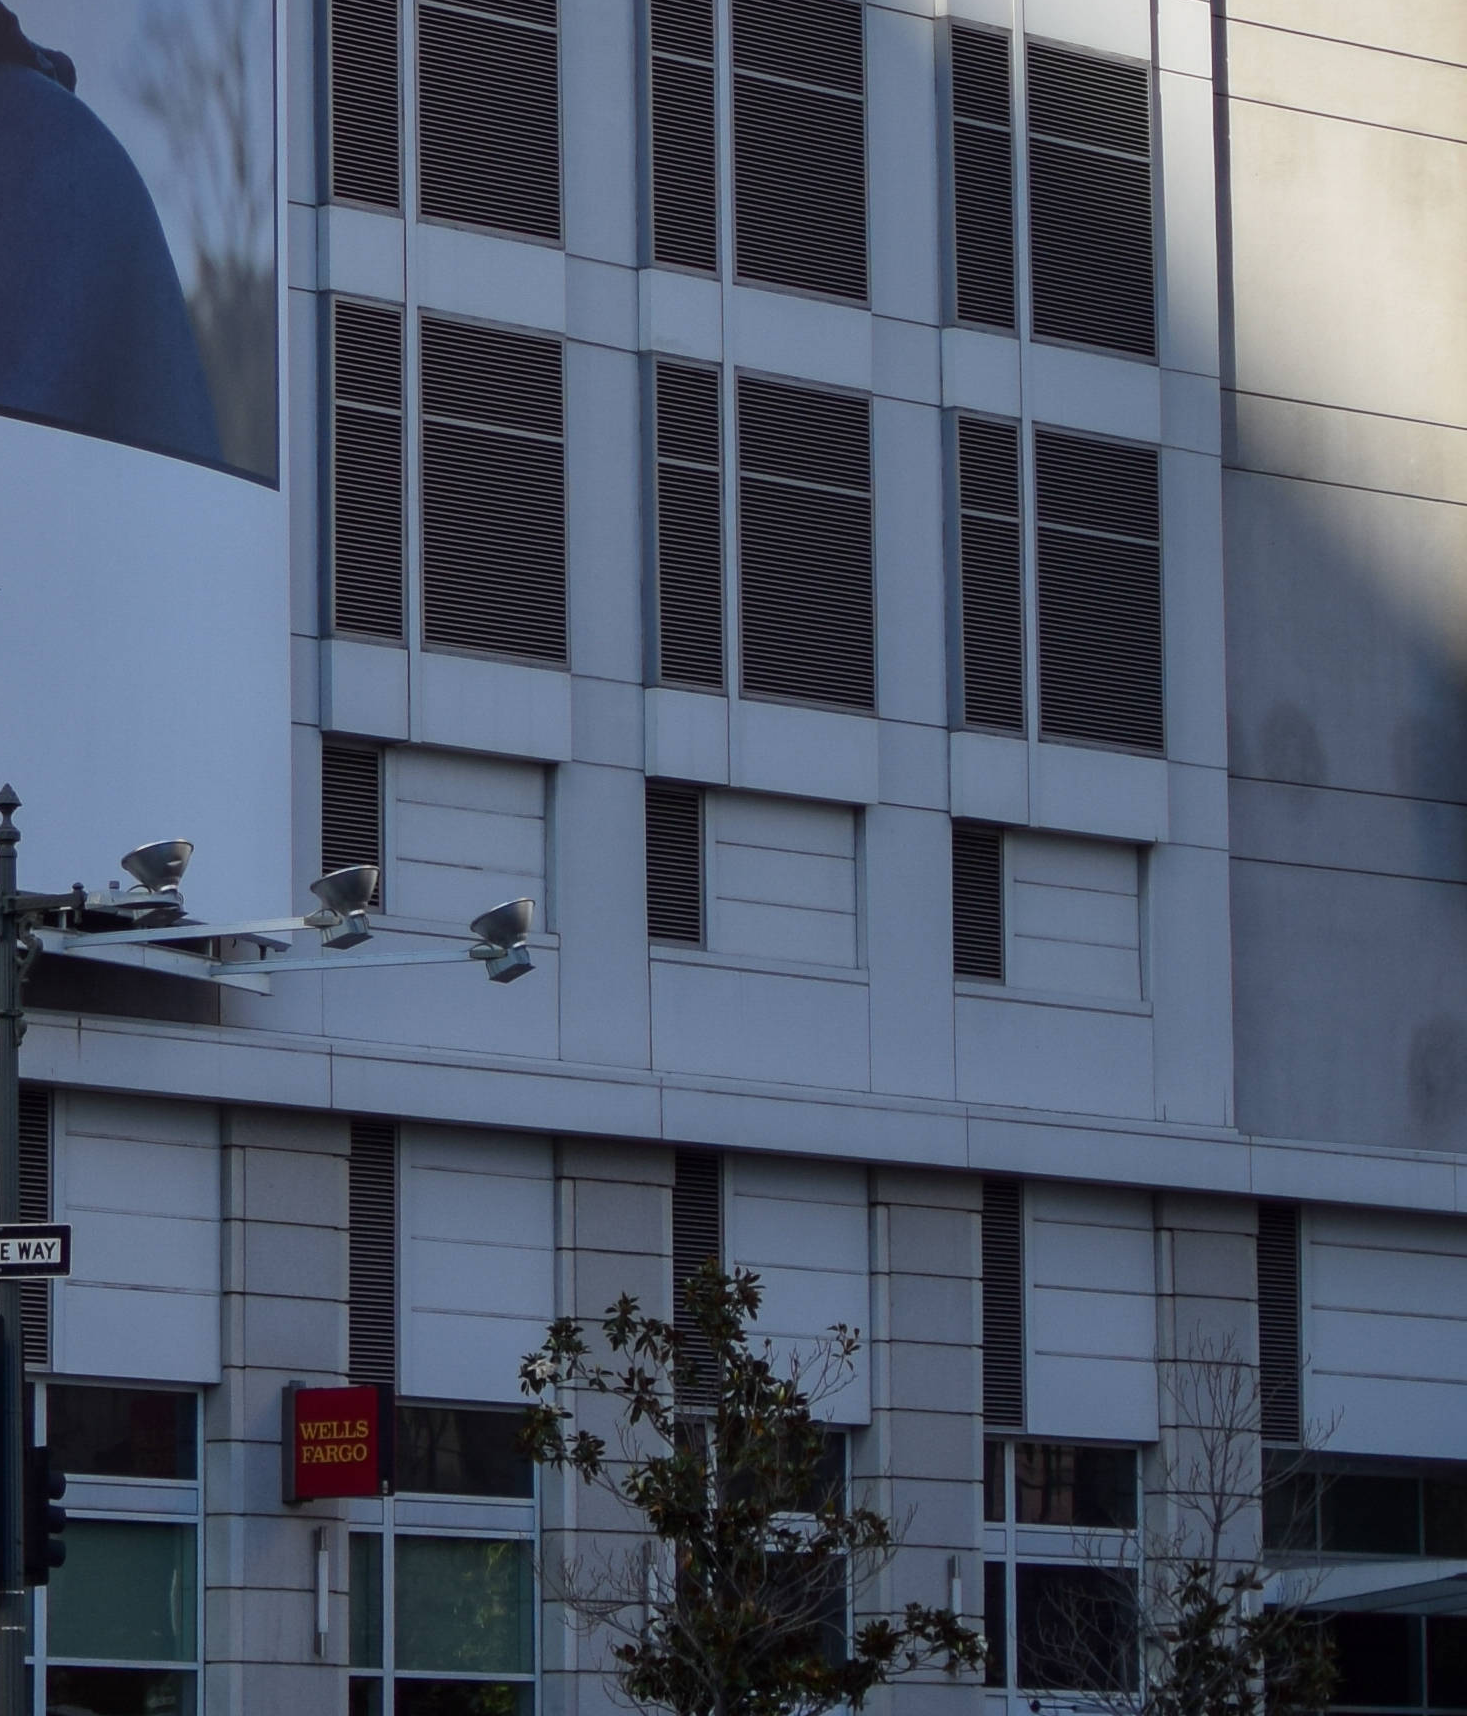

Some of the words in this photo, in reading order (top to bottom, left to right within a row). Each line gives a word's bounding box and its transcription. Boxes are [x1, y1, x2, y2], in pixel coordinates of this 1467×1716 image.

[18, 1241, 56, 1260] WAY
[299, 1420, 369, 1440] WELLS
[301, 1443, 368, 1464] FARGO
